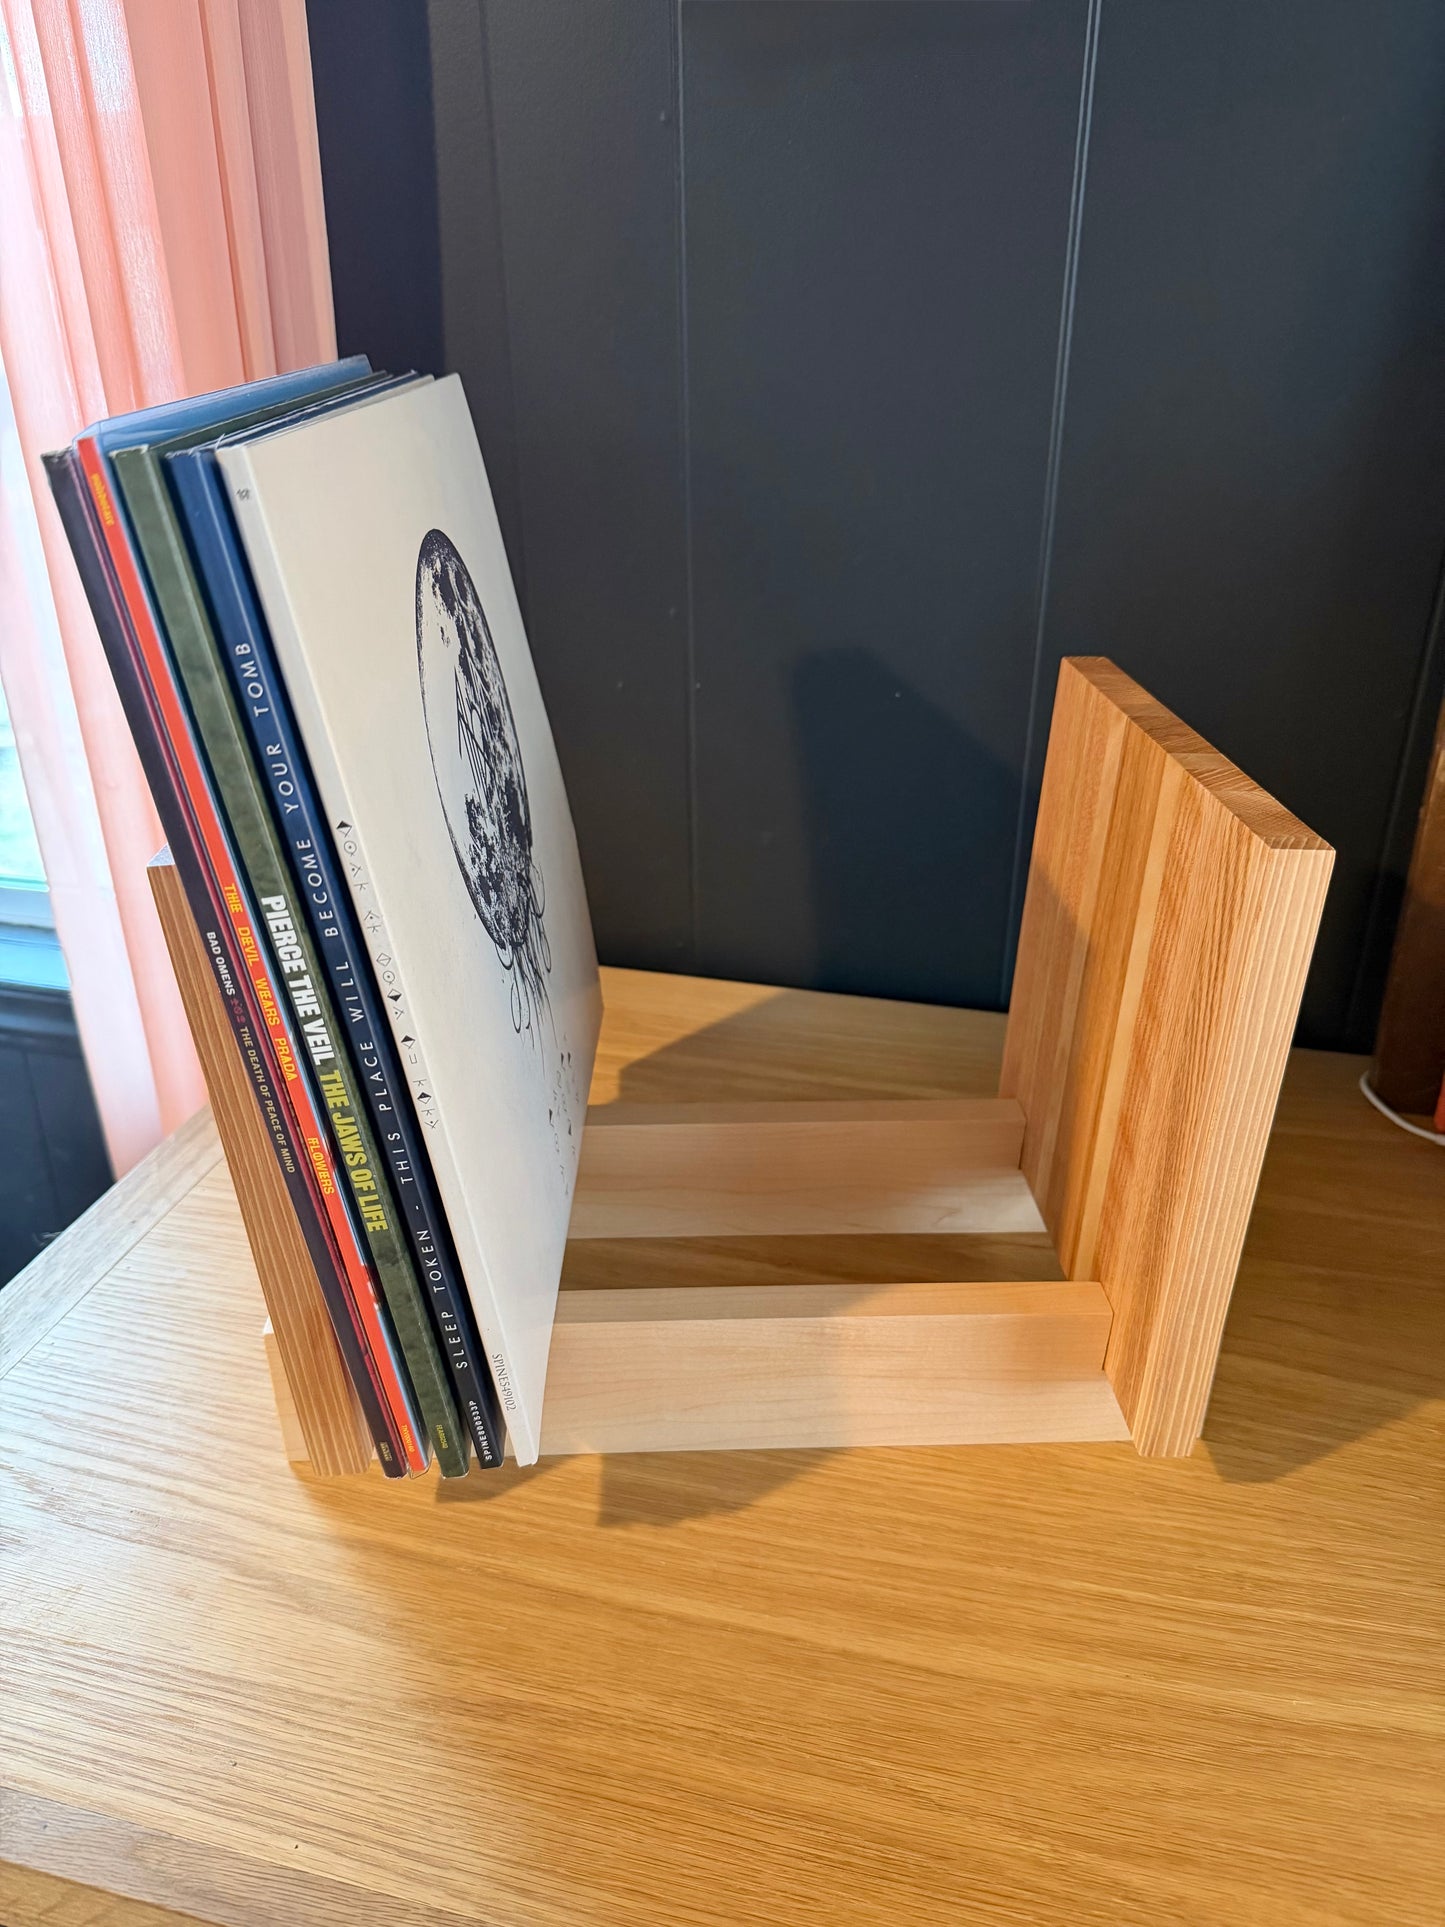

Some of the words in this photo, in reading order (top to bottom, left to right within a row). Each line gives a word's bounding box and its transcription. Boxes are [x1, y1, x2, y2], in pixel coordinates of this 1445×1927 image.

[235, 642, 270, 717] TOMB
[266, 743, 299, 815] YOUR
[296, 838, 339, 937] BECOME
[261, 895, 307, 974] PIERCE
[206, 931, 221, 955] BAD
[215, 956, 236, 996] OMENS
[224, 883, 243, 913] THE
[238, 927, 260, 967] DEVIL
[255, 977, 280, 1026] WEARS
[274, 1037, 298, 1081] PRADA
[288, 974, 321, 1018] THE
[335, 961, 365, 1023] WILL
[239, 1026, 254, 1048] THE
[303, 1018, 335, 1066] VEIL
[247, 1049, 266, 1083] DEATH
[259, 1085, 271, 1098] OF
[319, 1069, 351, 1109] THE
[360, 1041, 392, 1112] PLACE
[264, 1100, 281, 1132] PEACE
[275, 1133, 287, 1146] OF
[331, 1112, 368, 1168] JAWS
[280, 1148, 296, 1174] MIND
[350, 1168, 377, 1195] OF
[387, 1131, 414, 1185] THIS
[357, 1195, 389, 1233] LIFE
[416, 1229, 446, 1294] TOKEN
[441, 1311, 468, 1370] SLEEP
